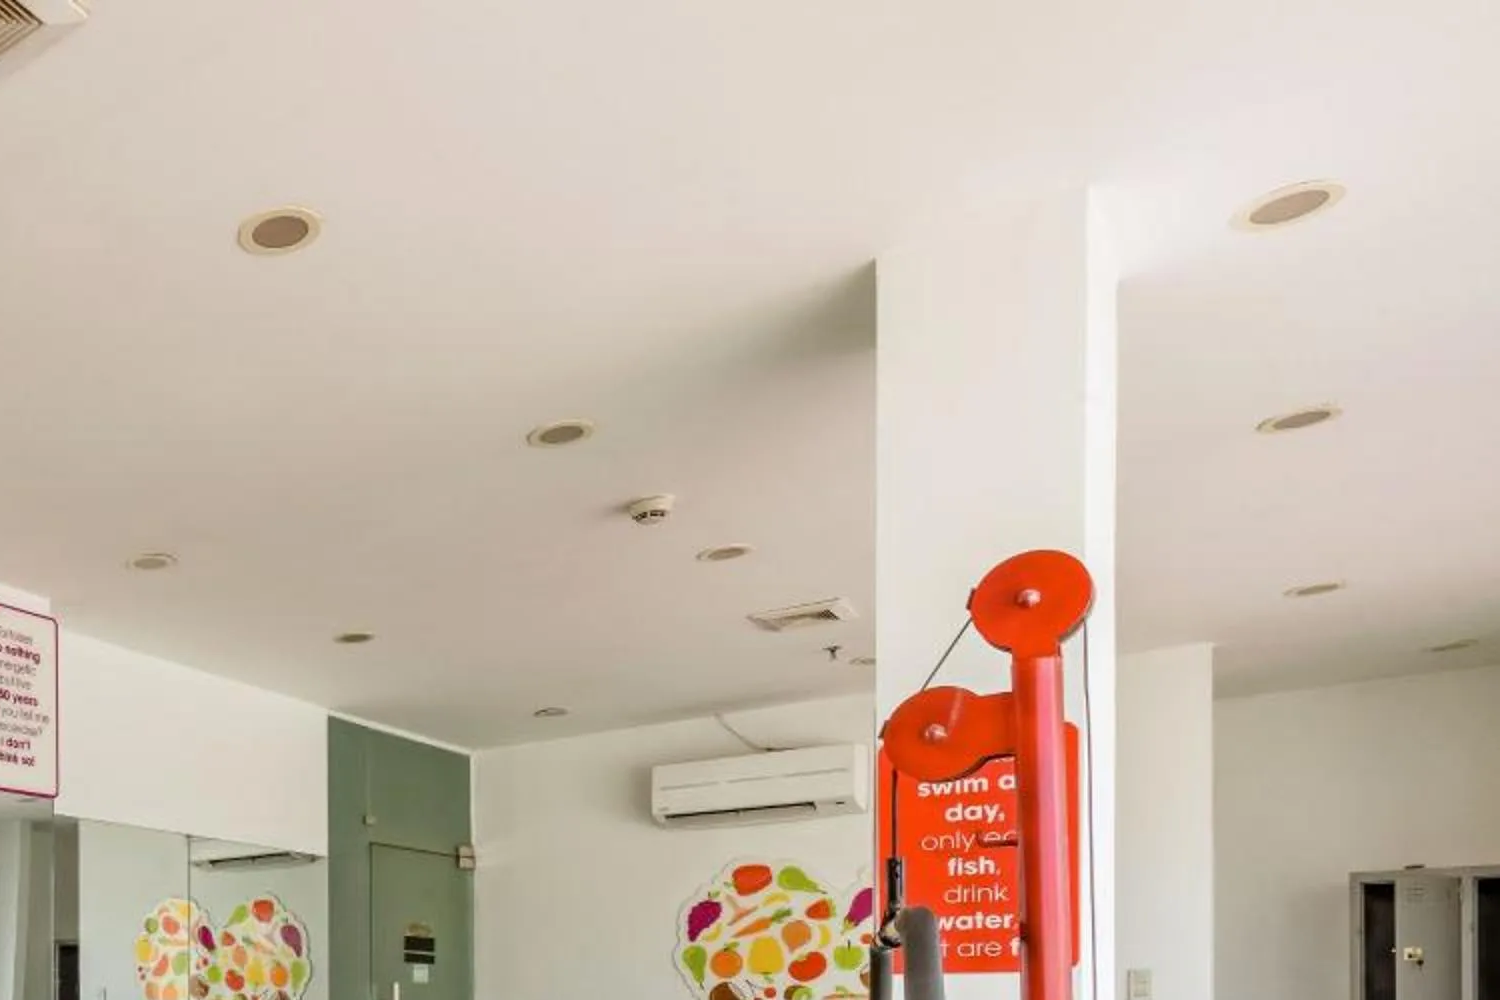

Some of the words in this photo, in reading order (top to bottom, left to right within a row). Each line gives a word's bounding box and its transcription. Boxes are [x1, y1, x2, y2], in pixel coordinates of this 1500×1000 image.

[5, 645, 41, 665] nothing
[12, 693, 38, 706] years
[917, 776, 989, 798] swim
[921, 831, 976, 852] only
[944, 884, 1009, 903] drink
[957, 941, 1002, 957] are
